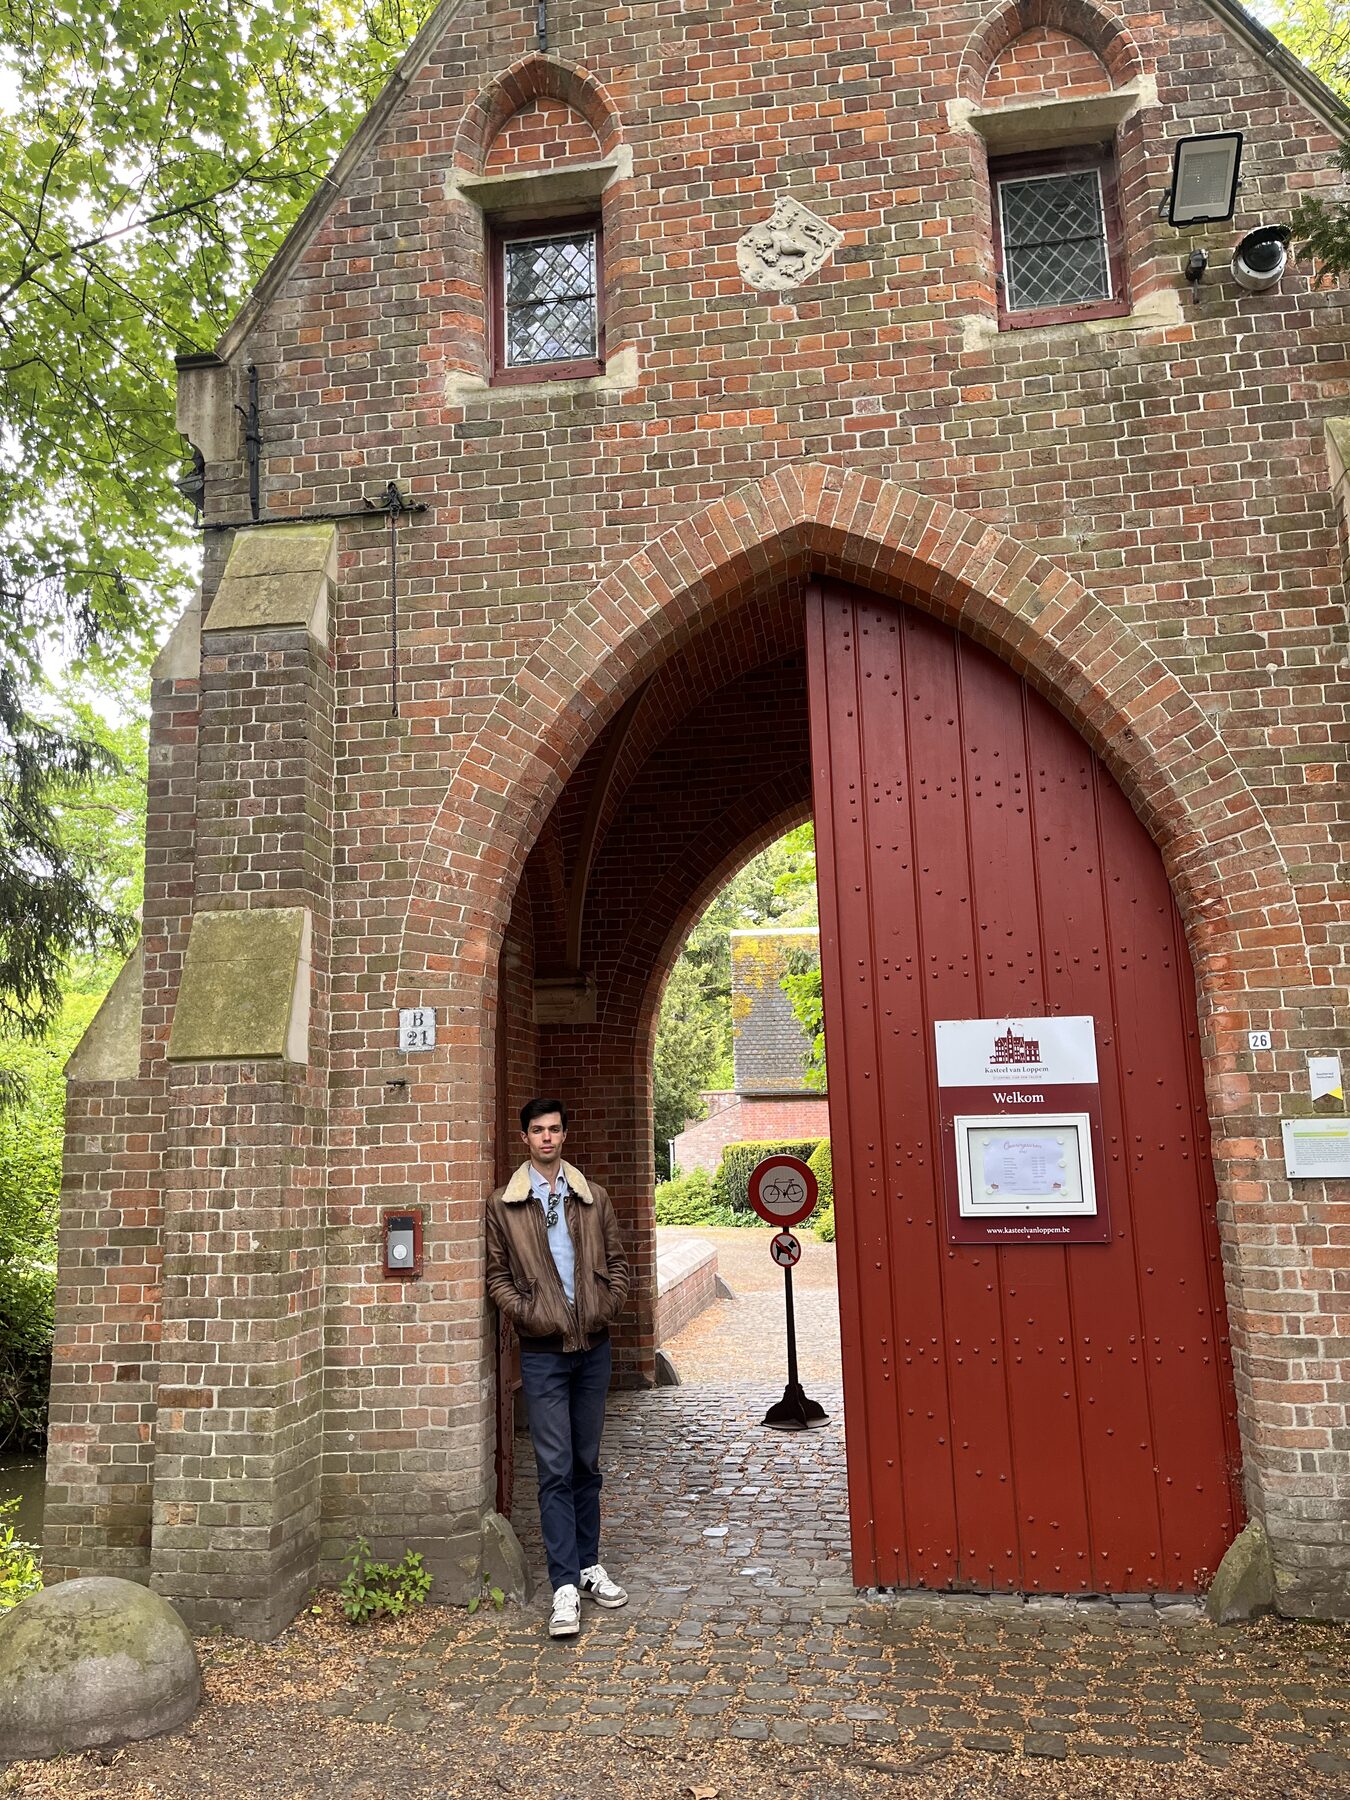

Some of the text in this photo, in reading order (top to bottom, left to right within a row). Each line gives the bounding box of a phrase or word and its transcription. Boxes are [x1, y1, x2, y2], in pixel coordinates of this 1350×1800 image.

[413, 1012, 424, 1027] B
[407, 1030, 427, 1046] 21
[1252, 1035, 1267, 1047] 26
[992, 1091, 1045, 1104] Welkom
[986, 1226, 1070, 1235] www.kasteelvanloppem.be
